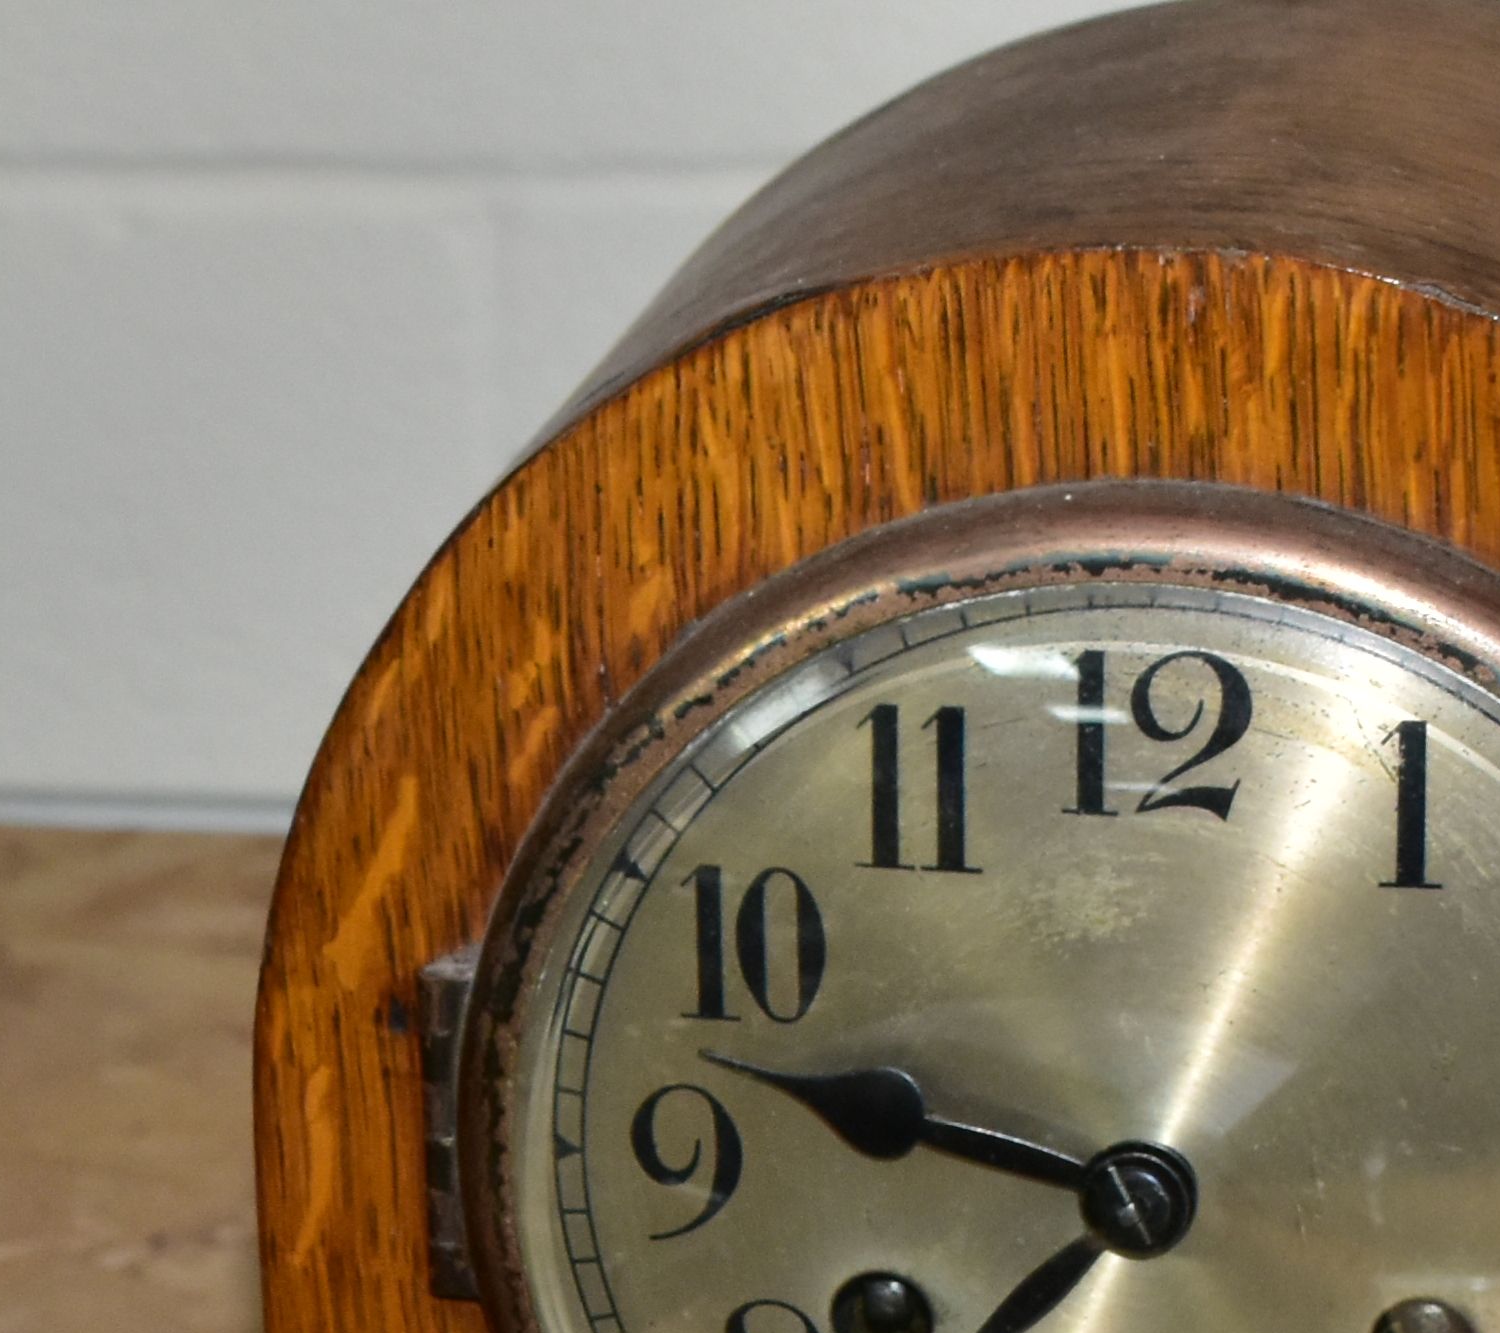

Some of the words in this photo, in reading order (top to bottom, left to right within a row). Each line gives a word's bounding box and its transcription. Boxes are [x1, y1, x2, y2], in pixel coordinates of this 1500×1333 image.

[854, 702, 985, 875] 11
[1061, 648, 1255, 822] 12
[1377, 719, 1445, 893] 1
[678, 862, 828, 1025] 10
[629, 1083, 743, 1242] 9
